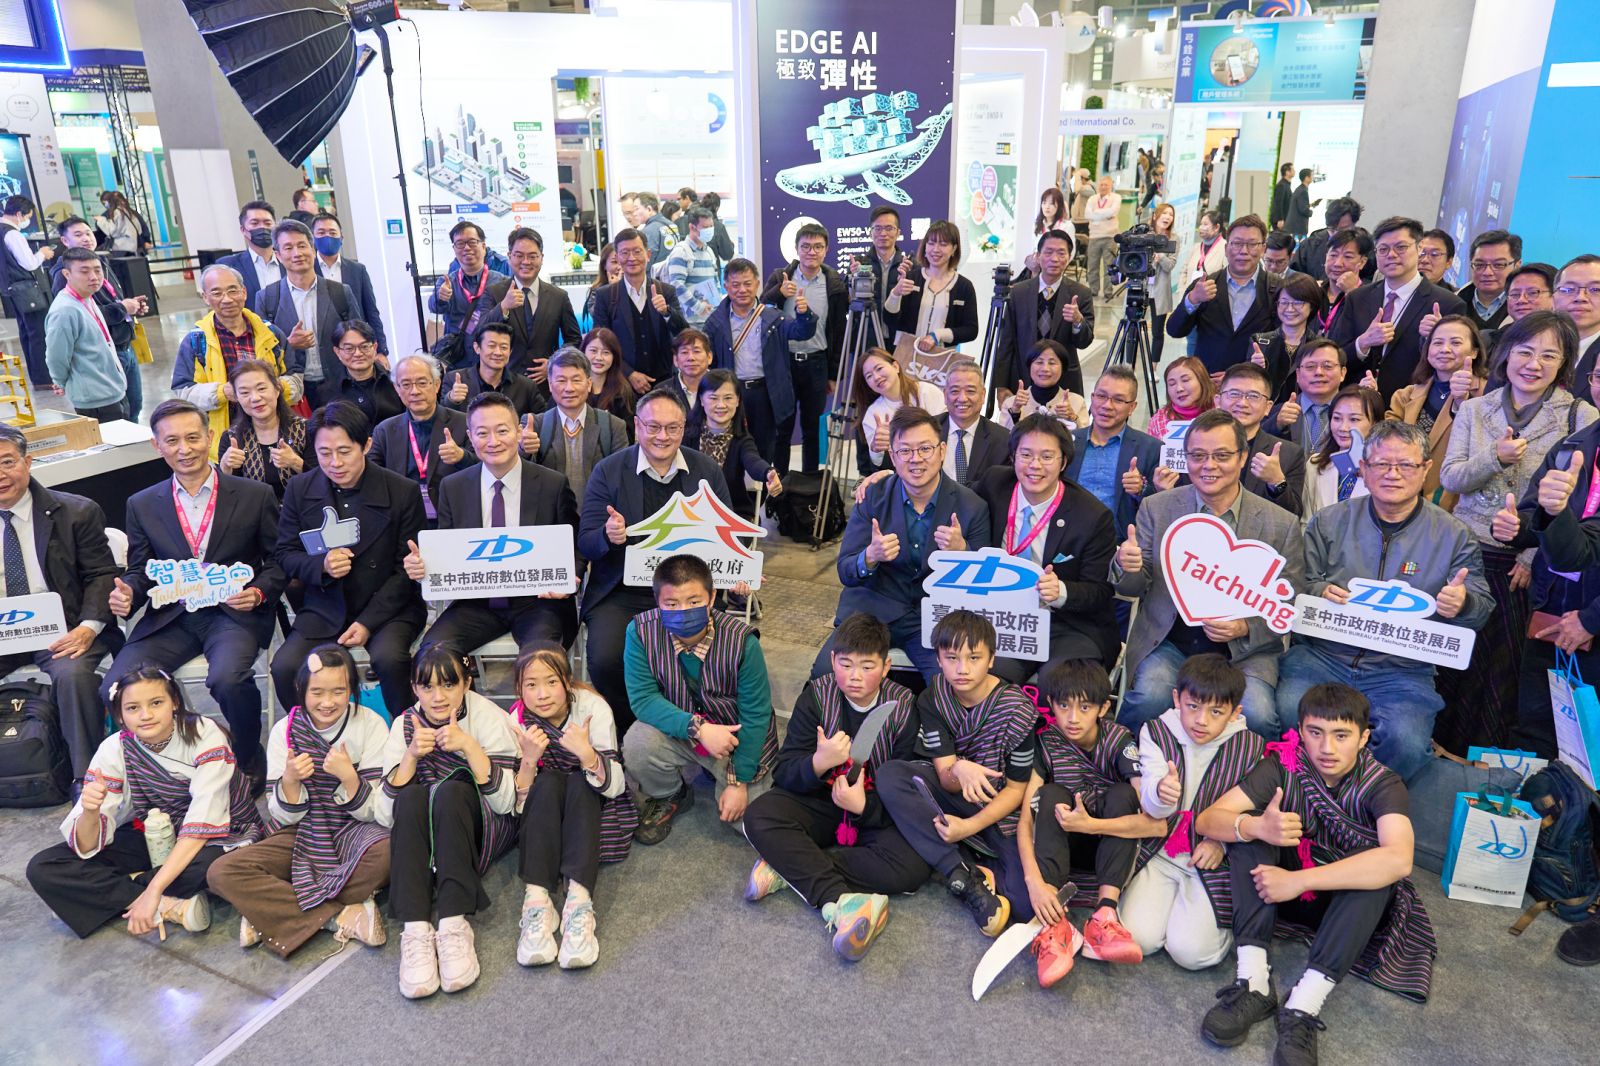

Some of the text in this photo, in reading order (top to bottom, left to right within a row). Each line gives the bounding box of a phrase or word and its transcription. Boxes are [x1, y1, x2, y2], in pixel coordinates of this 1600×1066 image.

[775, 30, 878, 55] EDGE AI
[776, 58, 878, 91] 極致彈性
[1070, 117, 1120, 127] International
[1122, 116, 1136, 126] Co.
[429, 567, 568, 587] 臺中市政府數位發展局
[644, 556, 744, 575] 臺政府
[1260, 558, 1281, 588] I
[151, 579, 204, 605] Taichung
[189, 592, 217, 610] Smart
[1180, 550, 1295, 631] Taichung
[932, 603, 1039, 633] 臺市政府
[1302, 605, 1461, 653] 臺中市政府數位發展局
[1301, 620, 1323, 629] DIGITAL
[1324, 624, 1348, 634] AFFAIRS
[1348, 629, 1372, 640] BUREAU
[1381, 637, 1407, 648] Taichung
[1408, 643, 1420, 652] City
[1421, 646, 1459, 659] Government
